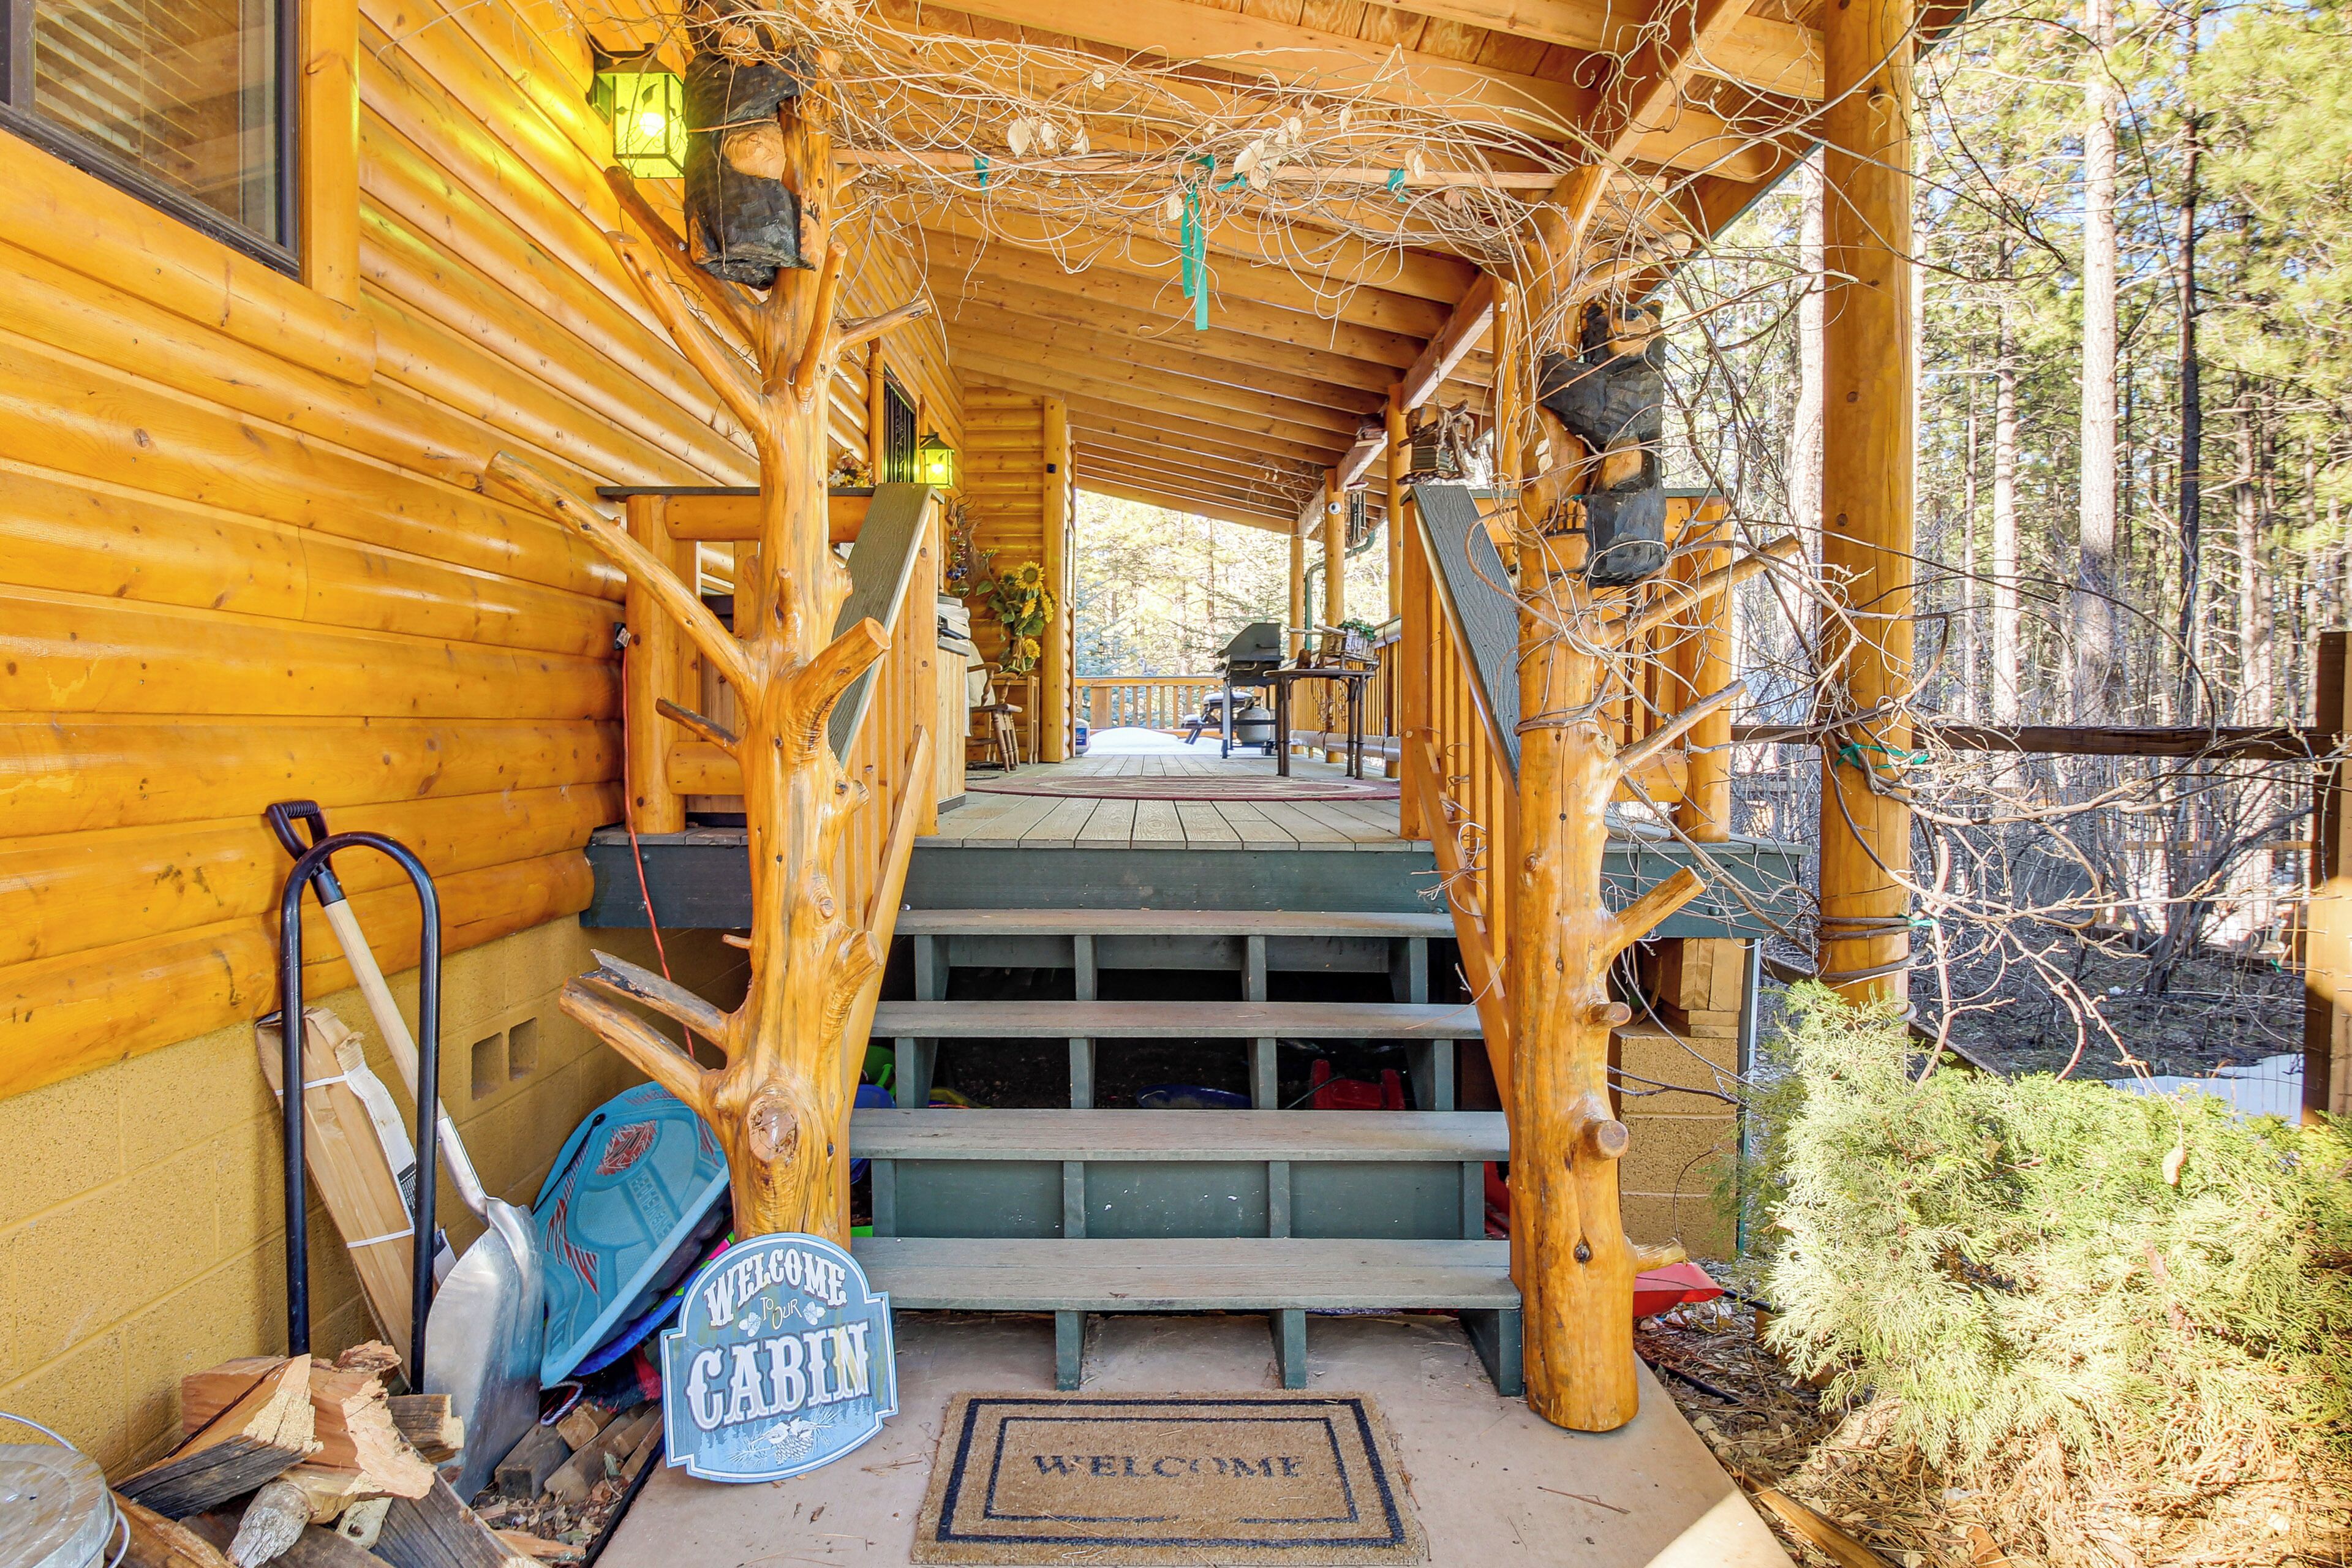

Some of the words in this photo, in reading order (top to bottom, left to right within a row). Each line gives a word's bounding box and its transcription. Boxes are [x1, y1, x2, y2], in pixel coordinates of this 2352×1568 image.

[704, 1248, 848, 1327] WELCOME
[760, 1296, 774, 1321] TO
[772, 1298, 802, 1330] OUR
[685, 1321, 870, 1431] CABIN
[1031, 1455, 1303, 1478] WELCOME
